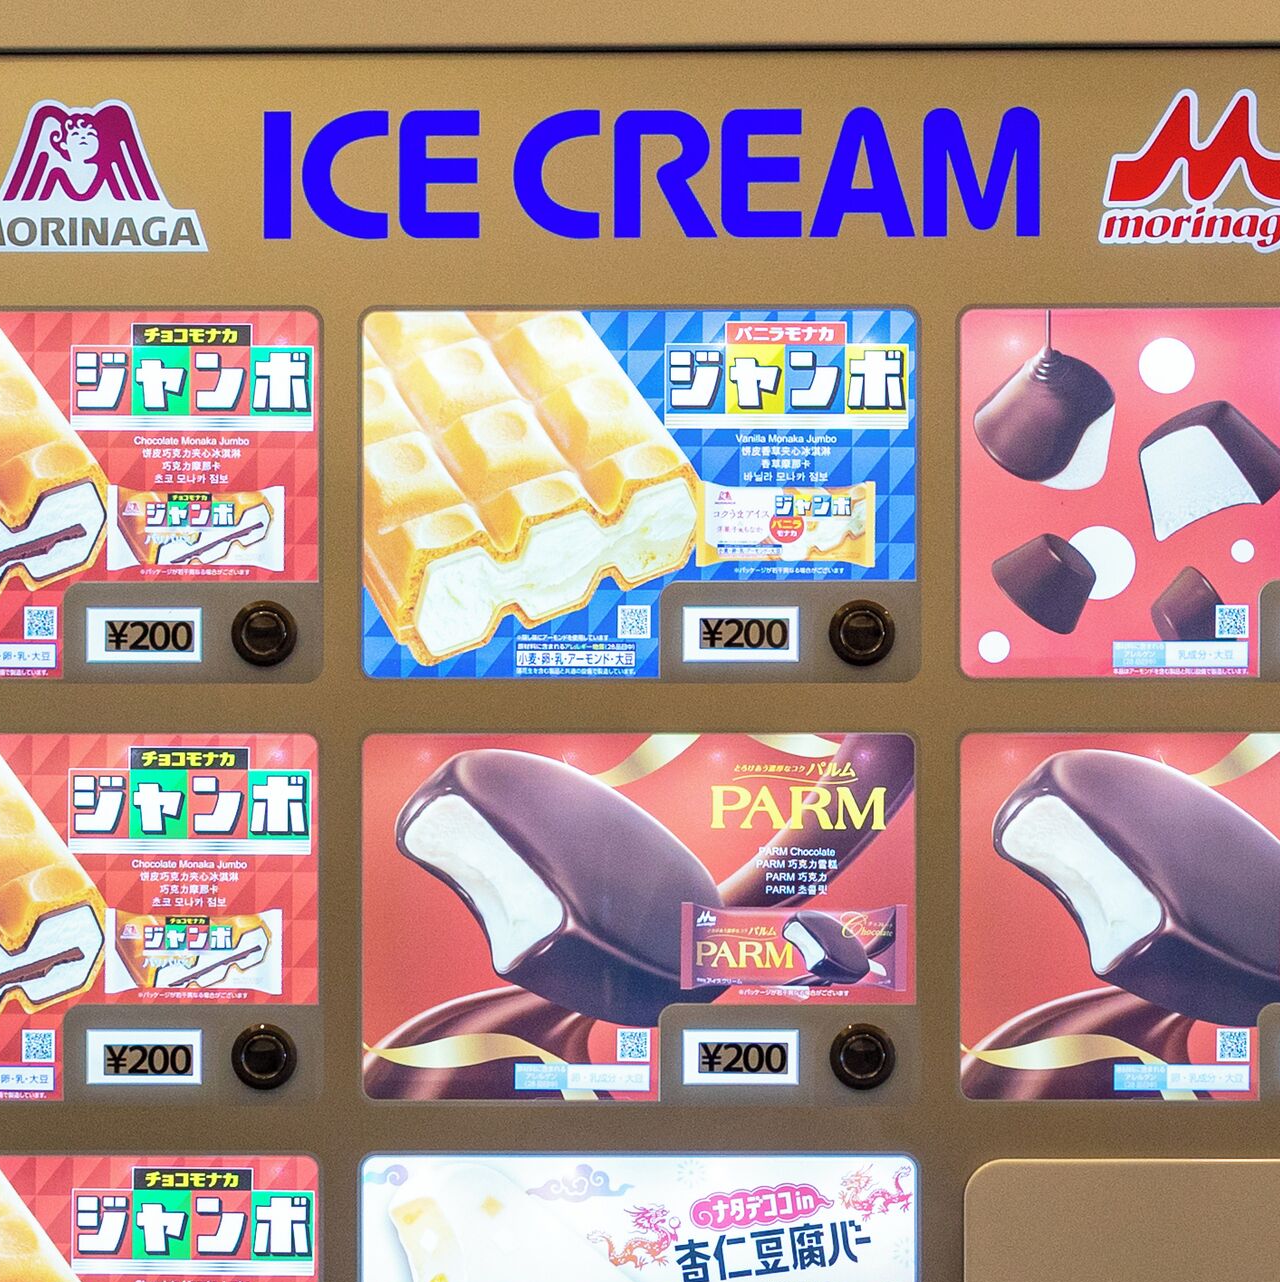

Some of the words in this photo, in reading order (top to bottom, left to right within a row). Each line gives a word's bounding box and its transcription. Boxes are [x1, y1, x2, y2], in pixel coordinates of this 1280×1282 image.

[263, 109, 480, 239] ICE
[513, 106, 1041, 239] CREAM
[144, 328, 238, 343] チョコモナカ
[735, 327, 834, 341] バニラモナカ
[76, 352, 311, 411] ジャンボ
[670, 351, 906, 409] ジャンボ
[134, 436, 179, 445] Chocolate
[181, 436, 217, 445] Monaka
[219, 436, 249, 445] Jumbo
[736, 435, 766, 443] Vanilla
[769, 435, 804, 443] Monaka
[806, 435, 837, 443] Jumbo
[147, 504, 234, 526] ジャンボ
[775, 495, 851, 516] ジャンボ
[771, 519, 803, 528] バニラ
[109, 621, 192, 650] ¥200
[702, 619, 788, 648] ¥200
[142, 751, 235, 767] チョコモナカ
[807, 762, 856, 777] パルム
[73, 775, 307, 835] ジャンボ
[711, 785, 887, 830] PARM
[759, 848, 788, 856] PARM
[790, 848, 835, 856] Chocolate
[132, 859, 177, 868] Chocolate
[179, 859, 214, 868] Monaka
[217, 859, 247, 868] Jumbo
[756, 860, 785, 868] PARM
[766, 873, 795, 881] PARM
[766, 886, 795, 894] PARM
[144, 927, 231, 949] ジャンボ
[696, 941, 793, 968] PARM
[107, 1045, 191, 1074] ¥200
[702, 1043, 786, 1072] ¥200
[145, 1171, 239, 1187] チョコモナカ
[713, 1191, 814, 1223] ナタデココin
[77, 1196, 312, 1256] ジャンボ
